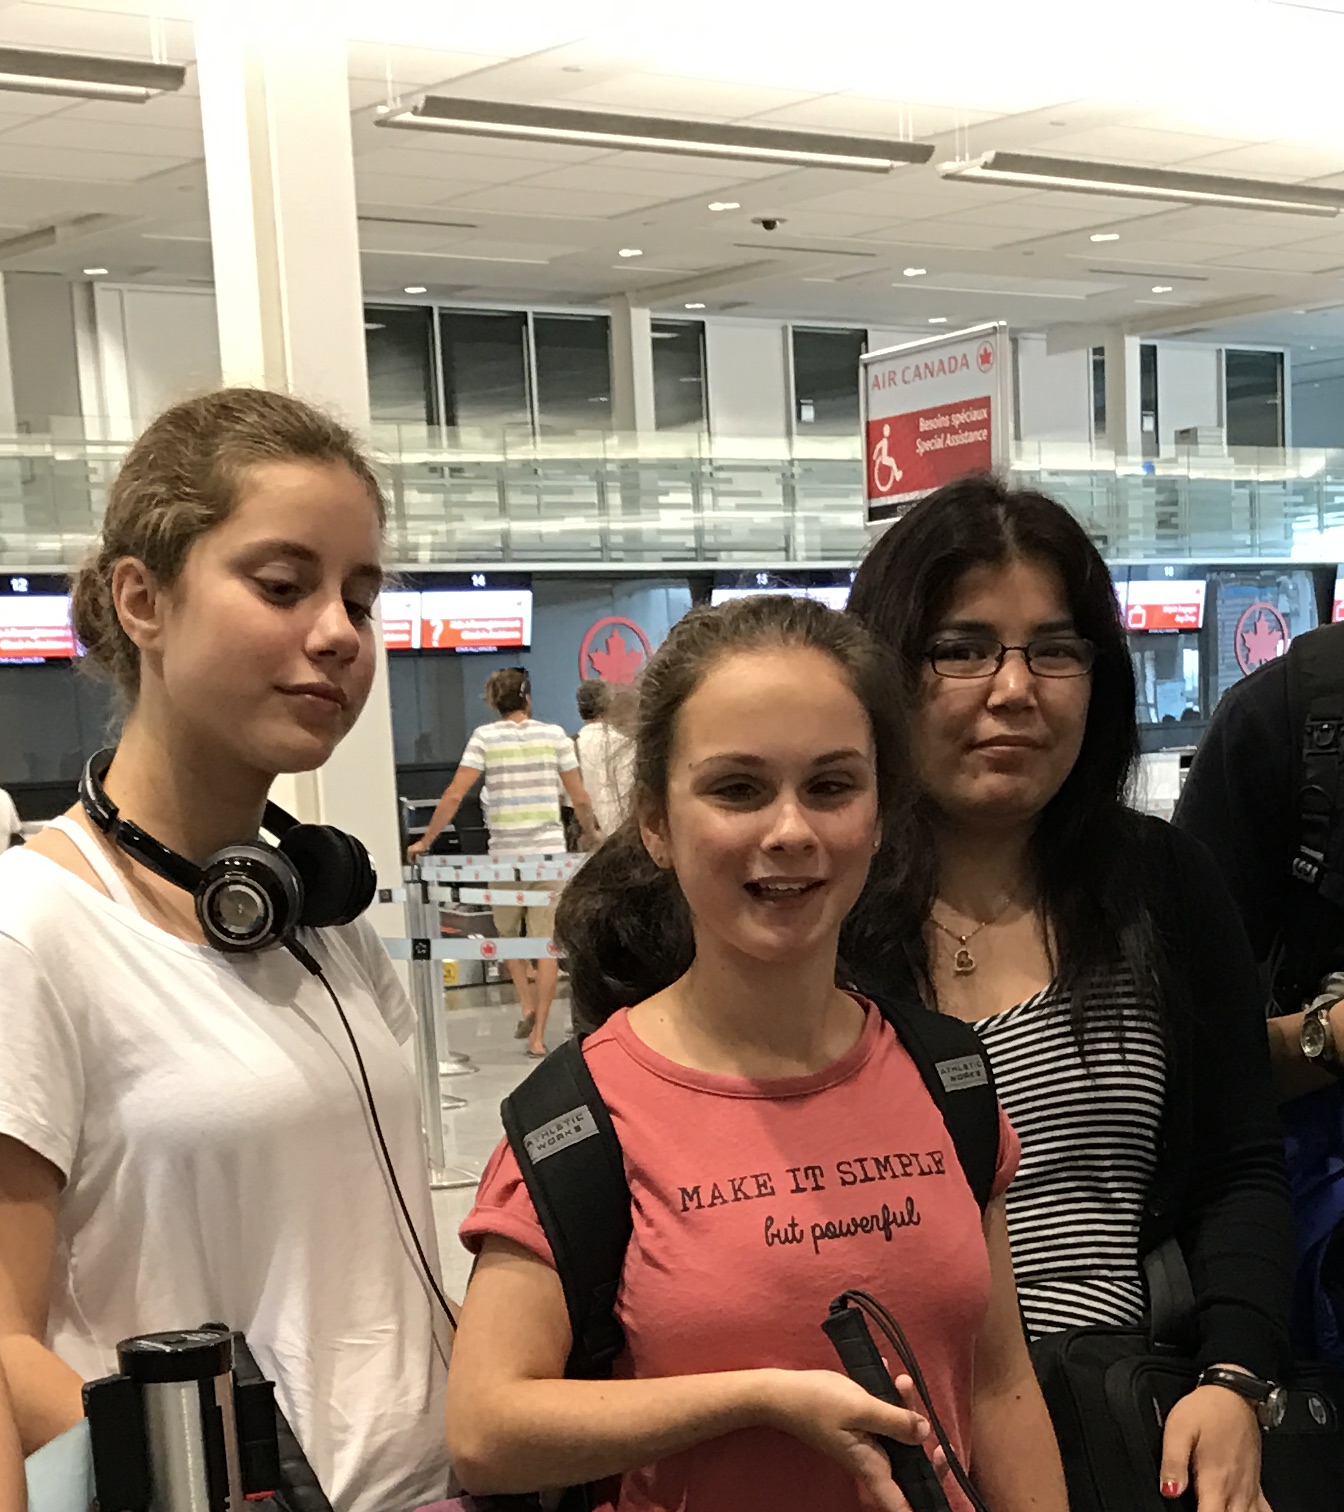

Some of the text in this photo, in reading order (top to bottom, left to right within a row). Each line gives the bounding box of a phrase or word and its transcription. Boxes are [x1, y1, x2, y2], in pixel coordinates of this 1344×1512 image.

[871, 352, 970, 391] AIR CANADA
[918, 414, 951, 432] Besoins
[916, 428, 988, 456] Special Assistance
[10, 577, 29, 592] 12
[471, 574, 486, 587] 14
[537, 1125, 582, 1151] WORKS
[678, 1150, 946, 1213] MAKE IT SIMPLE
[764, 1196, 921, 1255] but powerful
